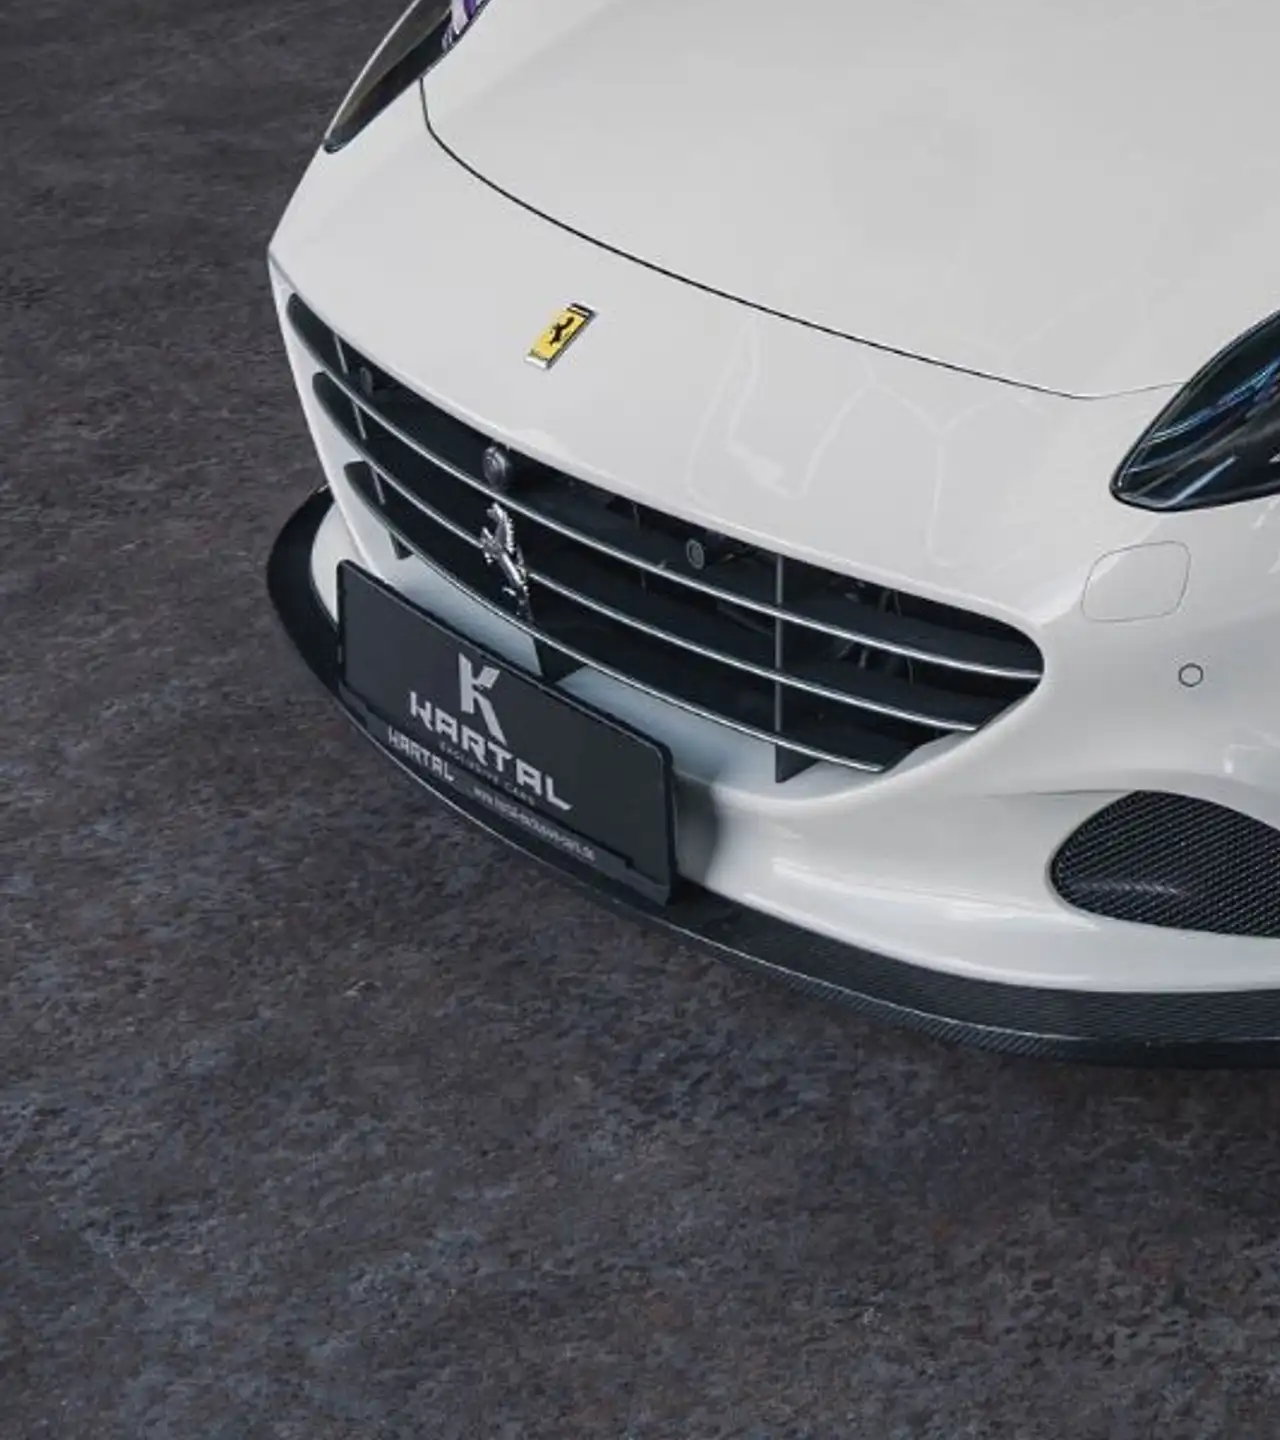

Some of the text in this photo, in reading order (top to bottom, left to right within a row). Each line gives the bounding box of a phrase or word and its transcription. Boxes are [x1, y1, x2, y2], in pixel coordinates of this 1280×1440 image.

[458, 651, 509, 747] K
[387, 724, 456, 783] KARTAL
[410, 690, 574, 812] KARTAL
